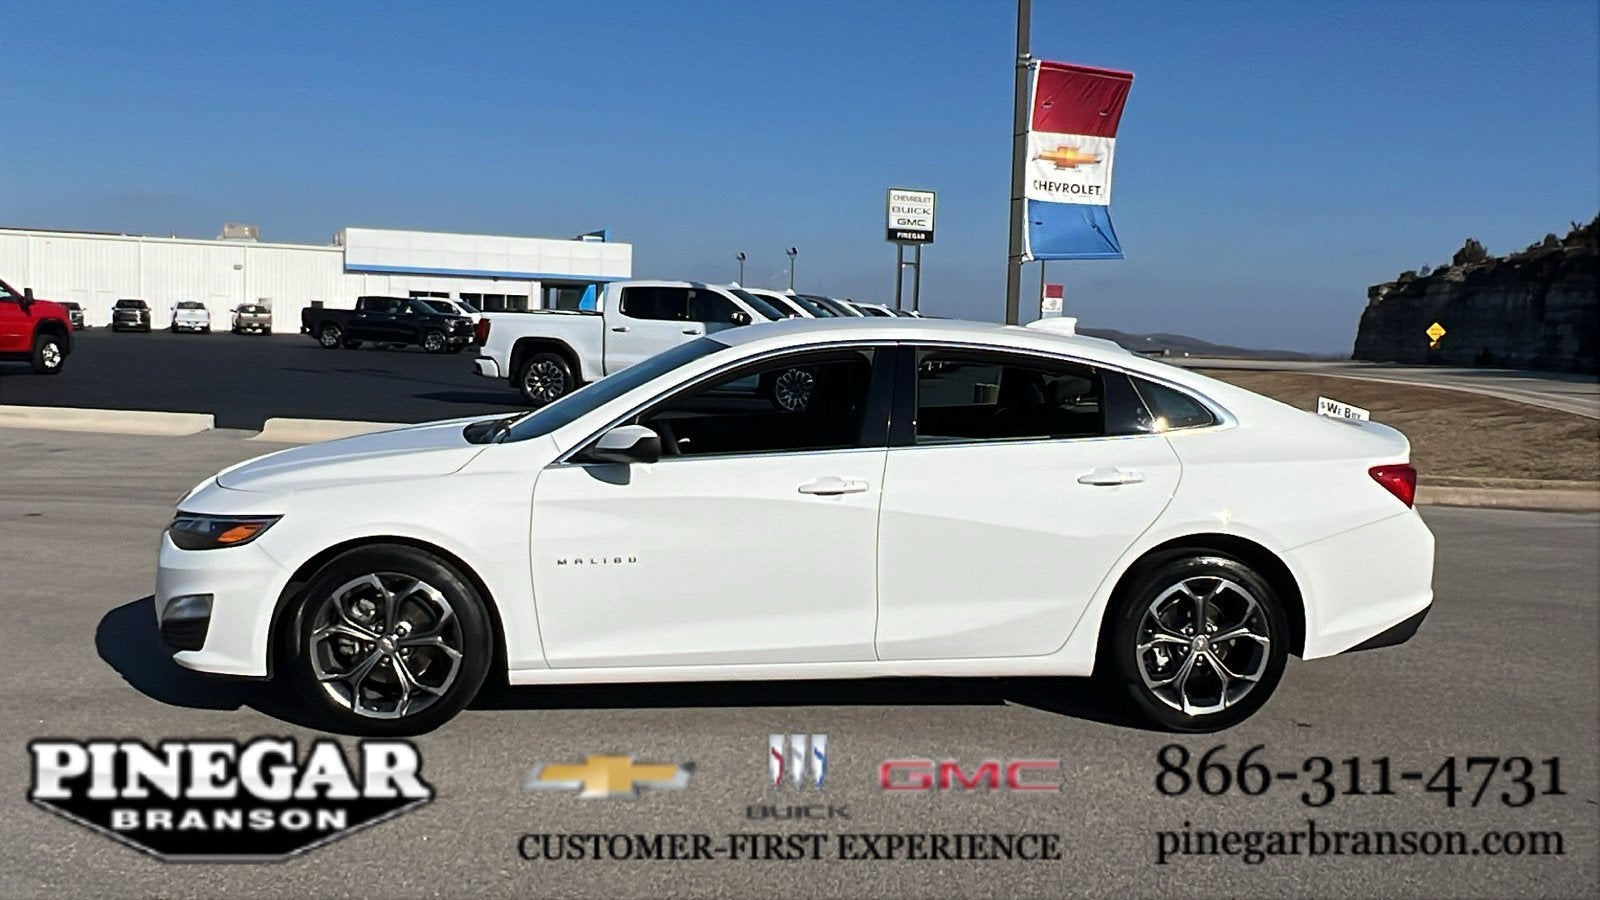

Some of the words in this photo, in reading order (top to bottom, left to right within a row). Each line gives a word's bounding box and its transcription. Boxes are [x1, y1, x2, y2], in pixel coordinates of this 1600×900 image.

[1033, 179, 1102, 196] CHEVROLET
[892, 194, 932, 203] CHEVROLET
[891, 205, 932, 215] BUICK
[897, 218, 926, 227] GMC
[896, 231, 926, 240] PINEGAR
[557, 556, 637, 565] MALIBU
